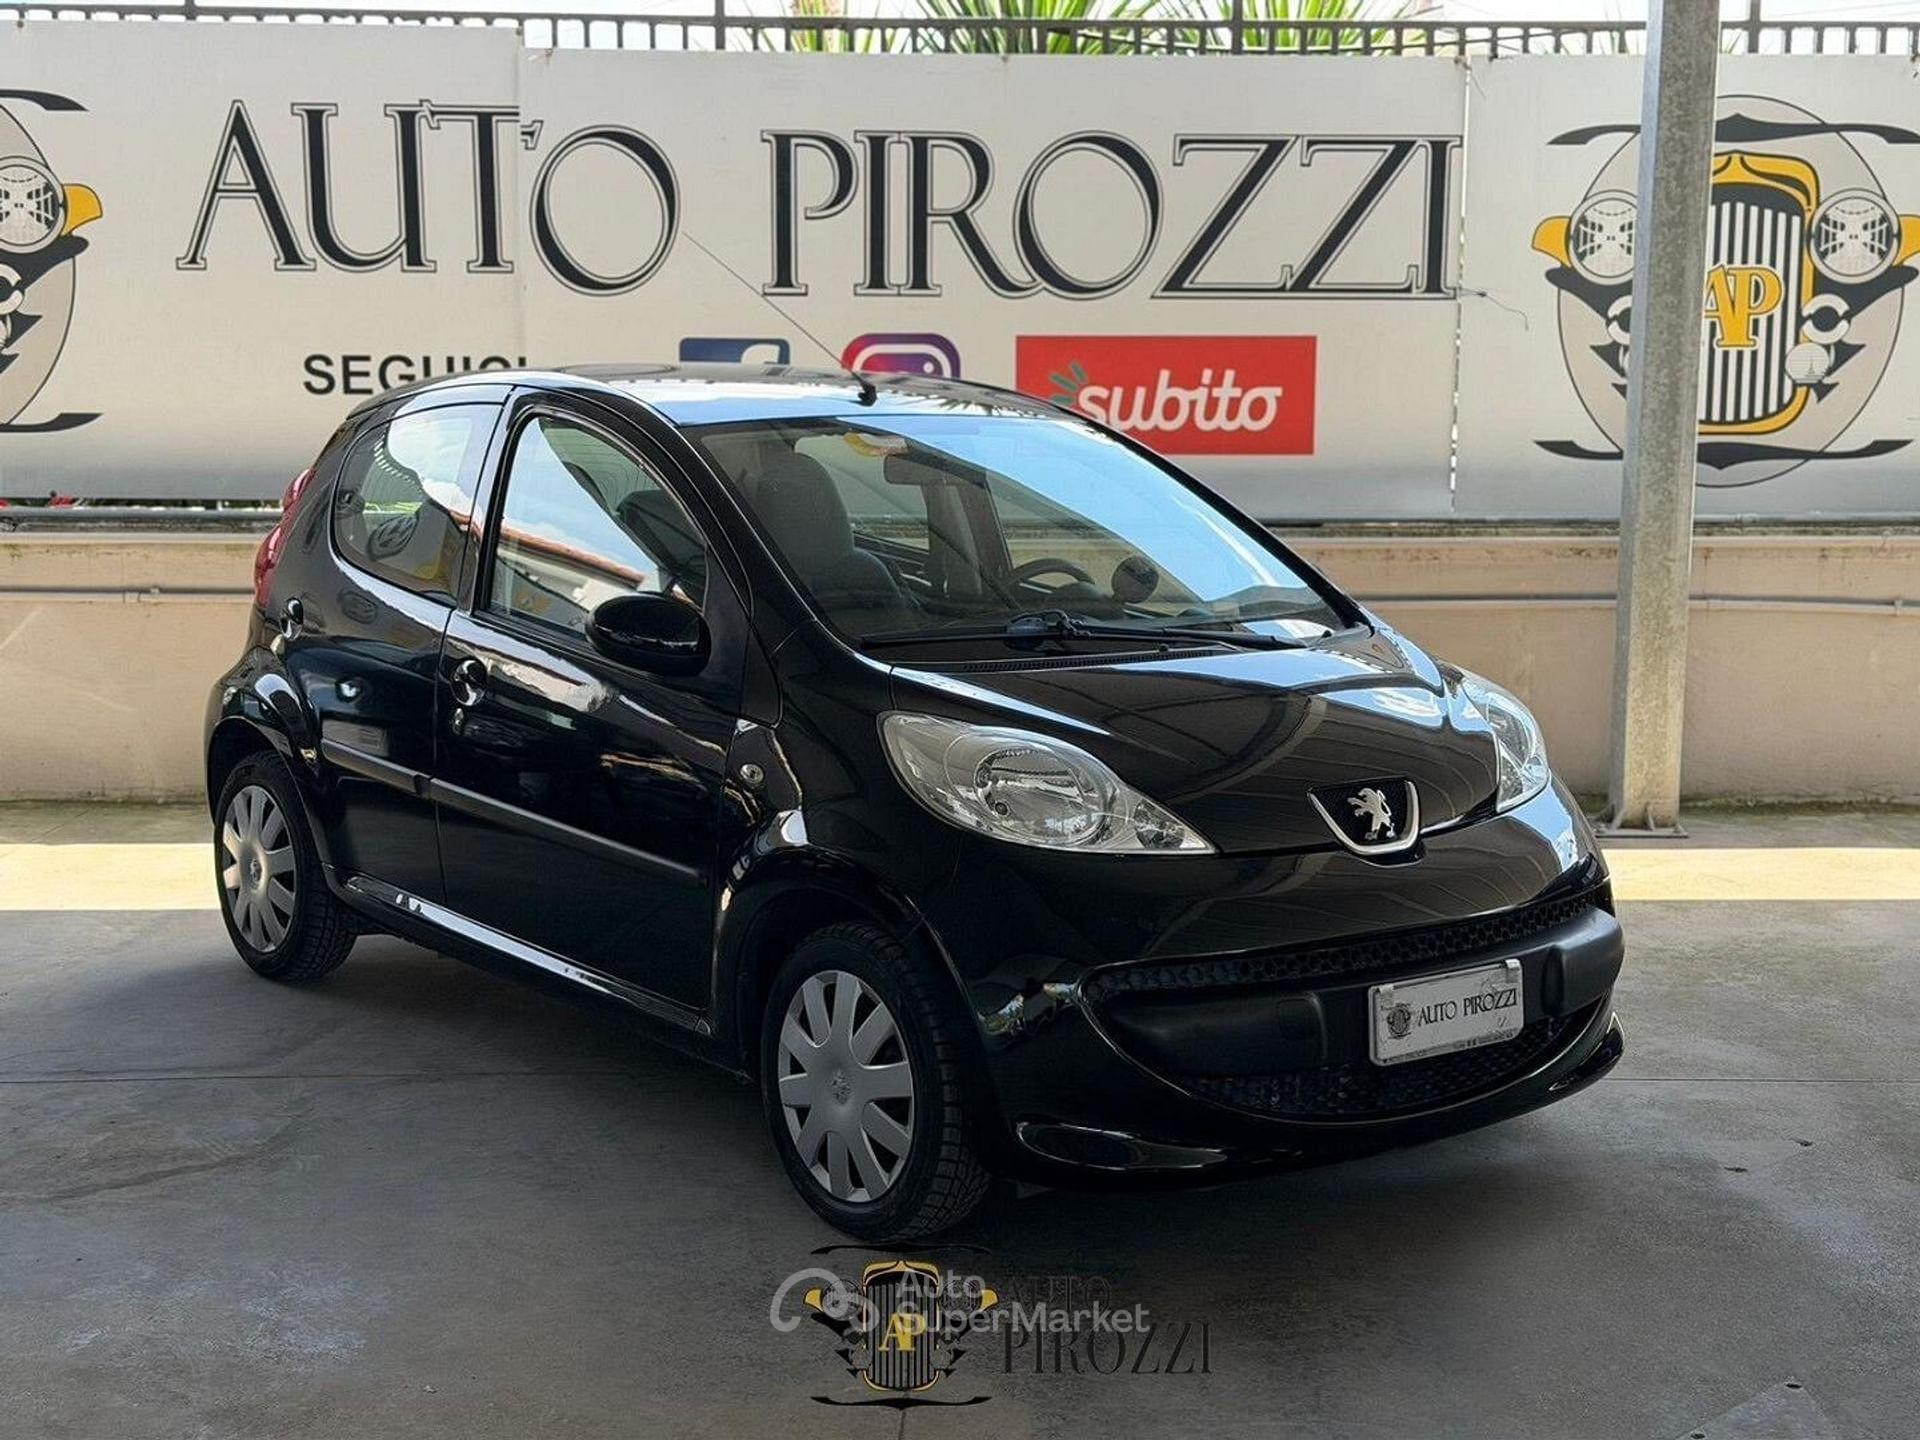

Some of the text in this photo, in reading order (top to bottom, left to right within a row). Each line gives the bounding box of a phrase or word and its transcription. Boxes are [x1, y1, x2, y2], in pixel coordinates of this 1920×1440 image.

[176, 100, 1463, 300] AUTO PIROZZI
[303, 354, 527, 395] SEGU
[1076, 367, 1283, 433] subito
[1418, 987, 1518, 1027] AUTO PIROZZI
